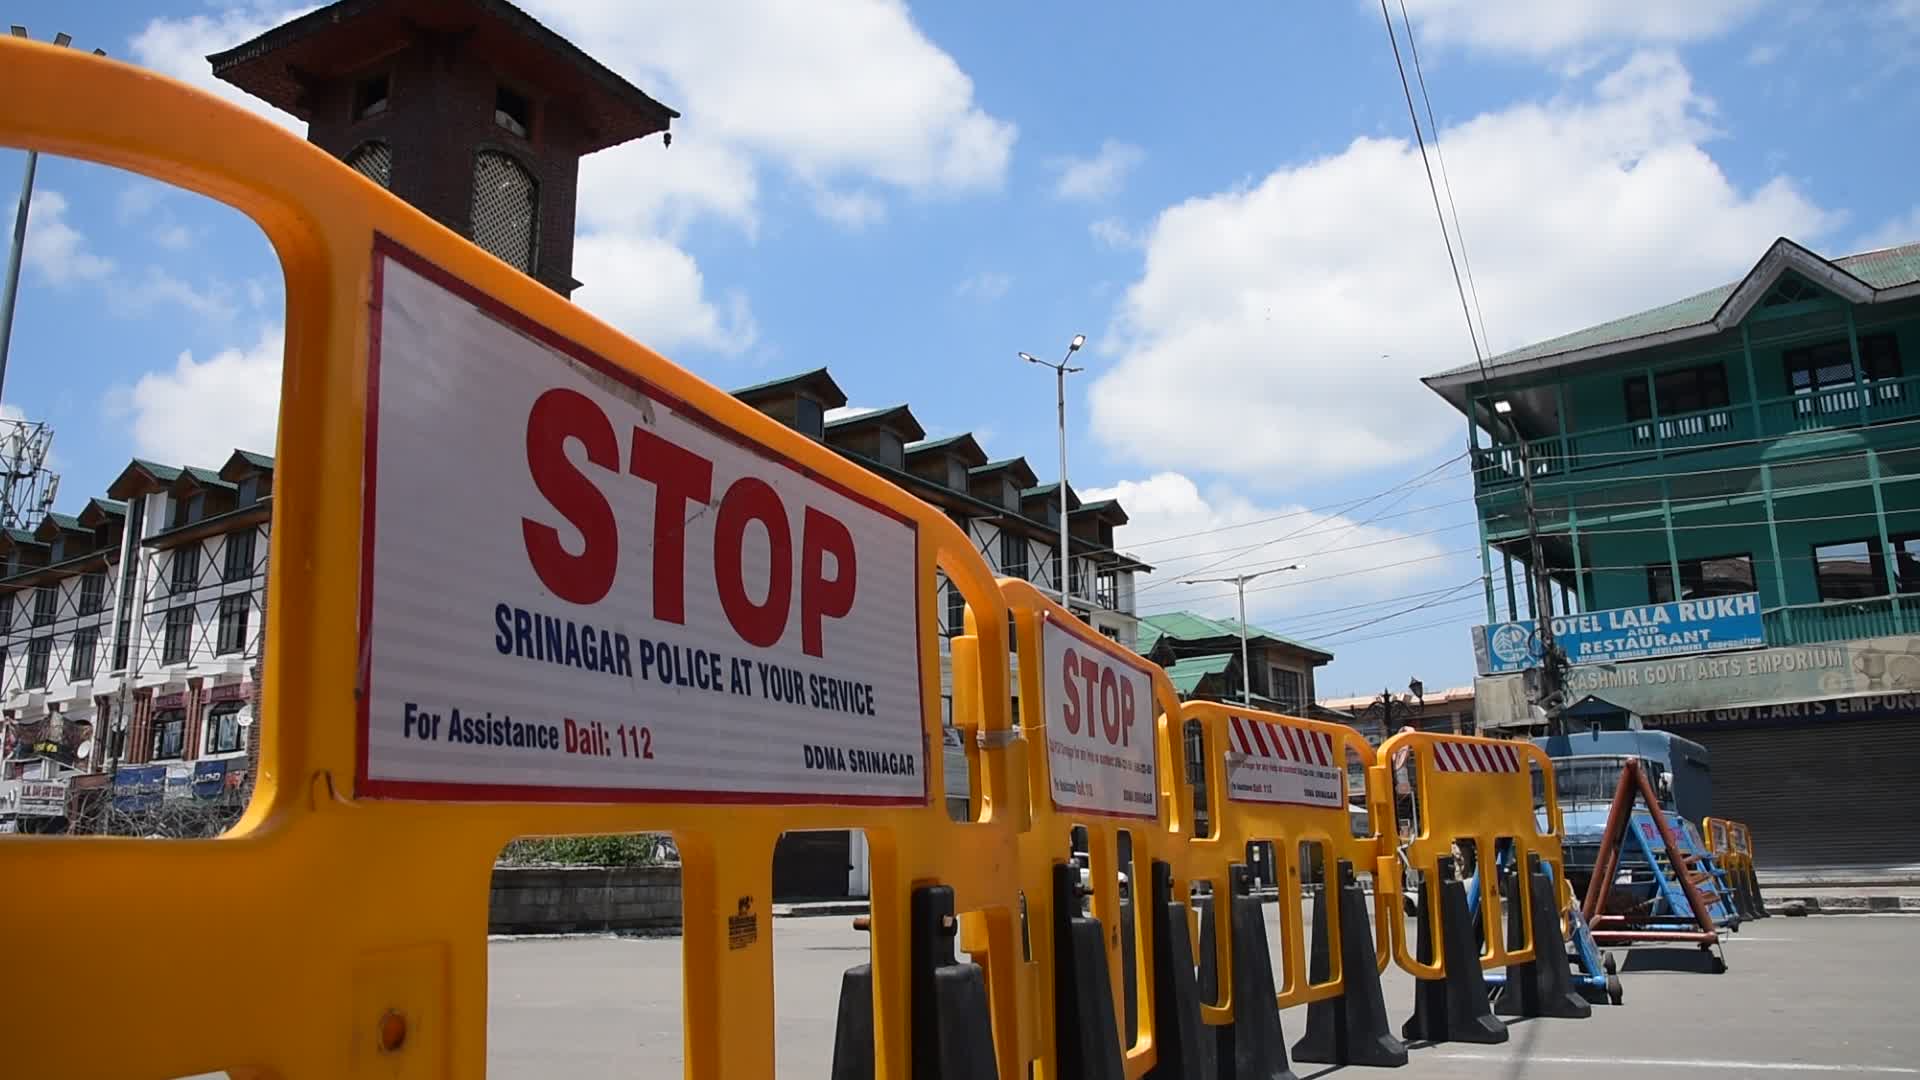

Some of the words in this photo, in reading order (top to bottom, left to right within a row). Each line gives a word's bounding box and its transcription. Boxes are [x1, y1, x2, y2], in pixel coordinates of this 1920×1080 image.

[520, 387, 857, 658] STOP
[1609, 605, 1672, 630] LALA
[1678, 594, 1756, 623] RUKH
[1627, 626, 1660, 637] AND
[495, 602, 633, 678] SRINAGAR
[639, 638, 724, 692] POLICE
[731, 657, 752, 696] AT
[757, 662, 806, 706] YOUR
[809, 673, 876, 717] SERVICE
[1580, 628, 1711, 655] RESTAURANT
[1568, 669, 1640, 692] KASHMIR
[1644, 663, 1692, 684] GOVT.
[1698, 658, 1741, 680] ARTS
[1748, 648, 1843, 675] EMPORIUM
[1063, 647, 1135, 747] STOP
[1836, 694, 1920, 713] EMPOR
[403, 702, 441, 741] For
[448, 708, 560, 750] Assistance
[564, 718, 612, 756] Dail:
[617, 724, 655, 760] 112
[803, 744, 847, 772] DDMA
[849, 748, 916, 776] SRINAGAR
